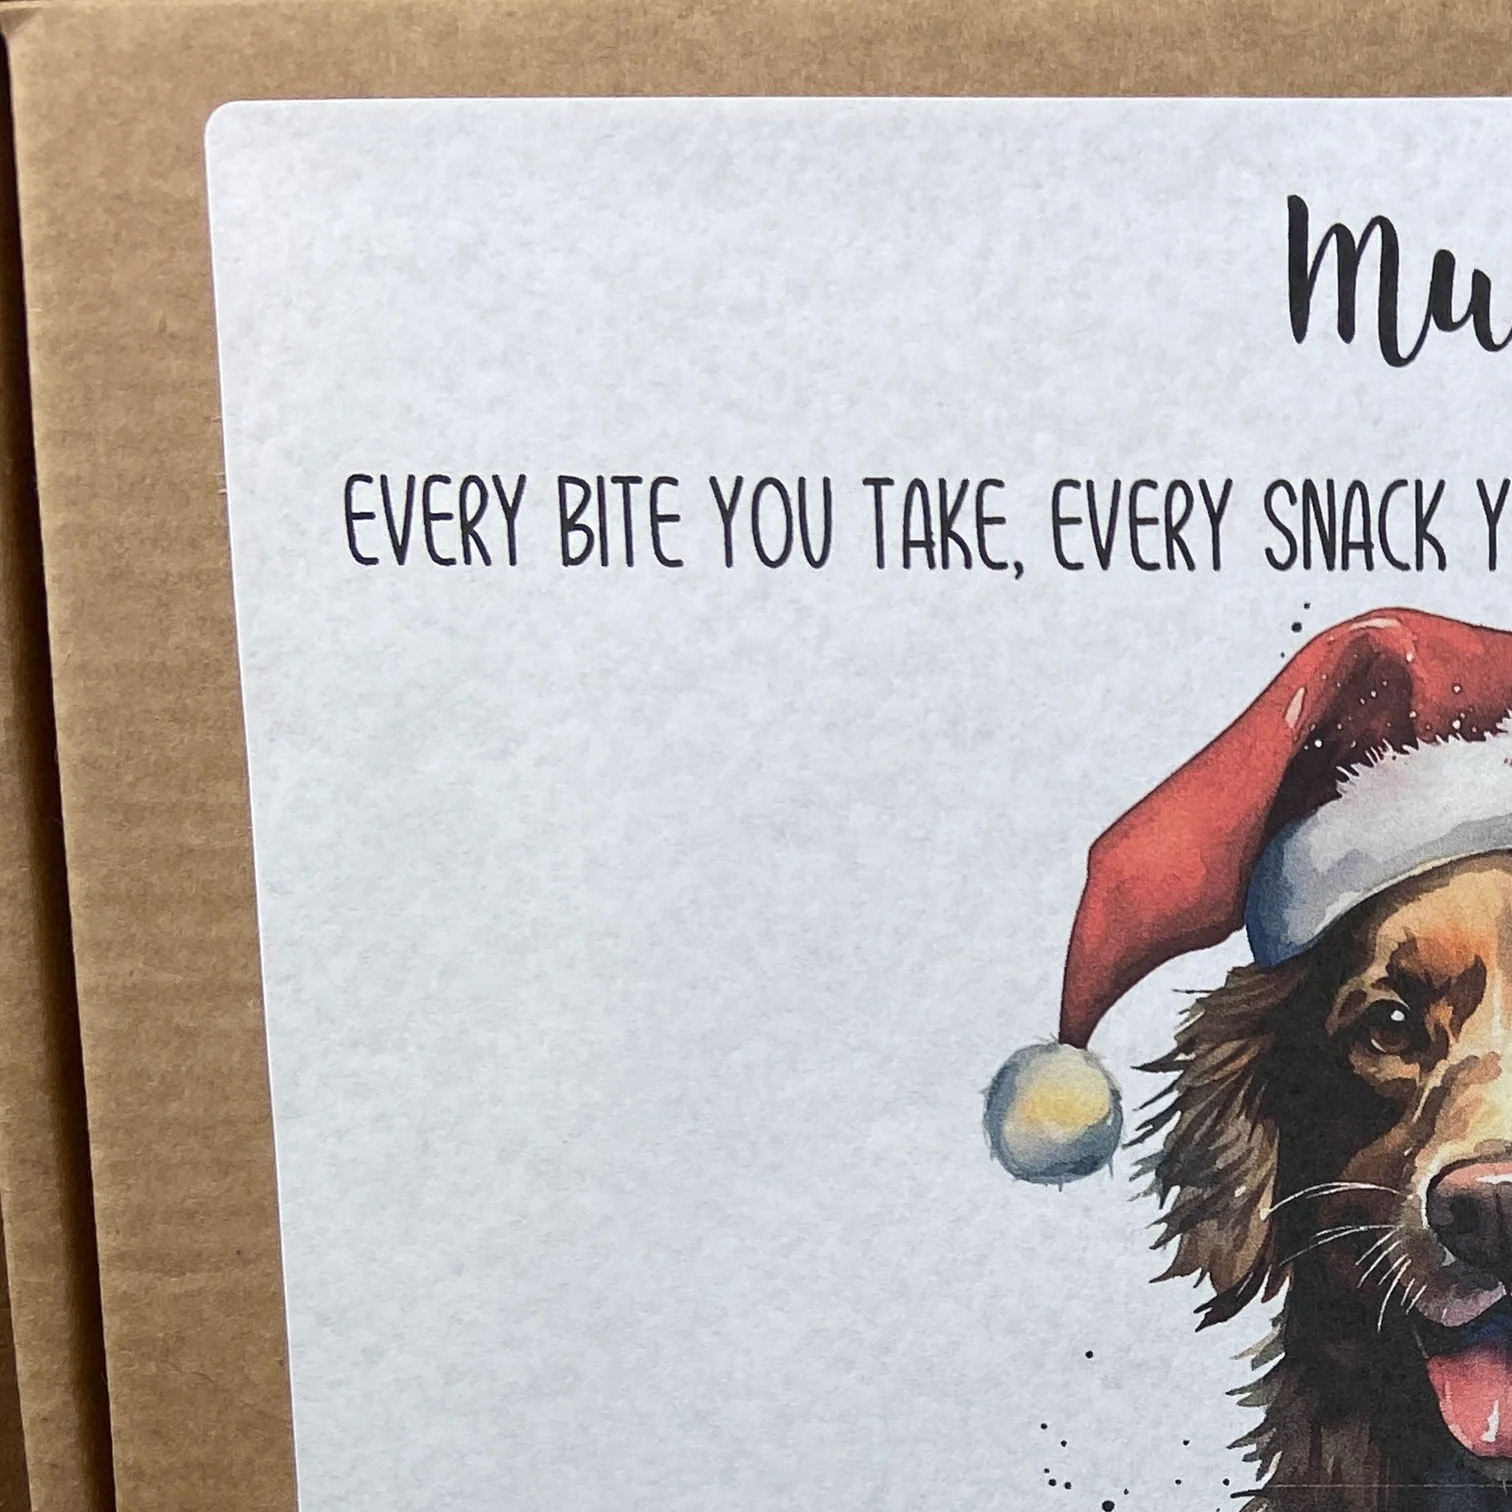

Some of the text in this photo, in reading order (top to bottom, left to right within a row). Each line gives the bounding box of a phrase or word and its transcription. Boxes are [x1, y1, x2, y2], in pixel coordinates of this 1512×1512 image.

[344, 473, 527, 567] EVERY
[557, 474, 684, 568] BITE
[709, 475, 832, 569] YOU
[862, 477, 1024, 580] TAKE,
[1051, 478, 1233, 572] EVERY
[1263, 478, 1447, 572] SNACK
